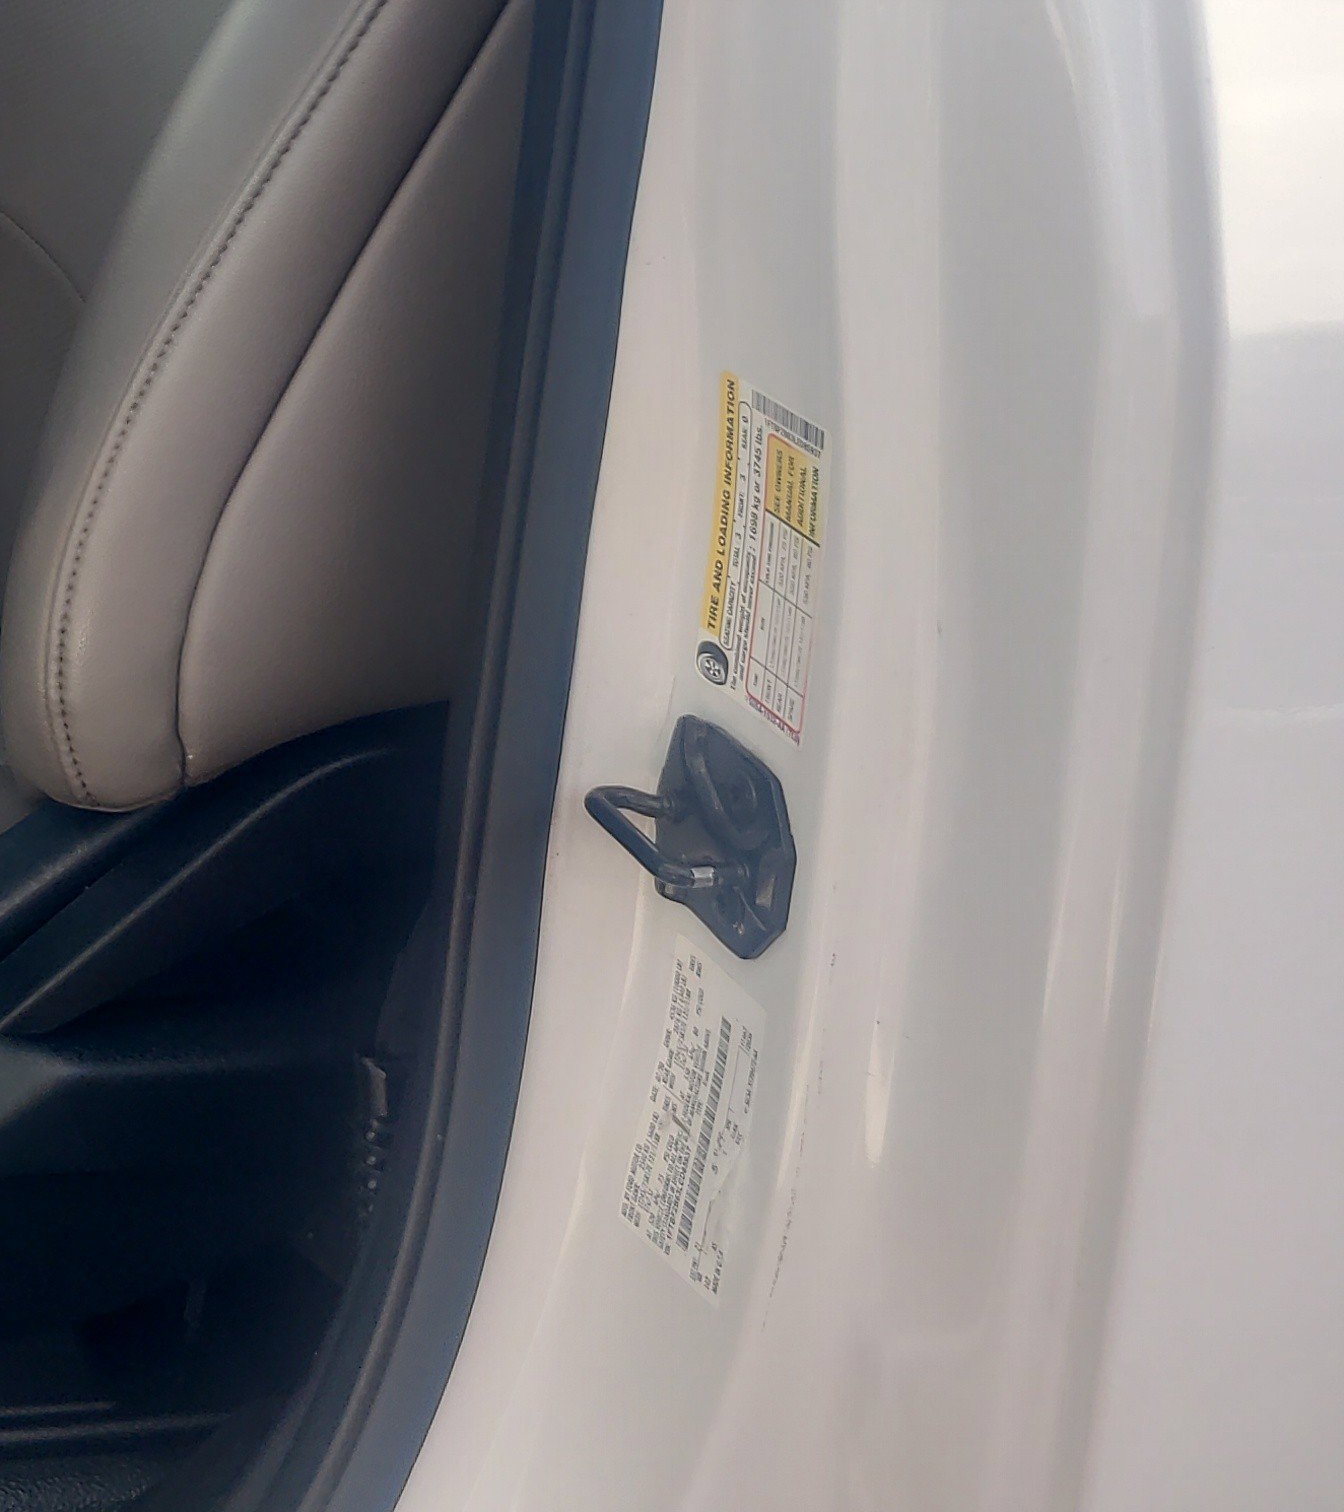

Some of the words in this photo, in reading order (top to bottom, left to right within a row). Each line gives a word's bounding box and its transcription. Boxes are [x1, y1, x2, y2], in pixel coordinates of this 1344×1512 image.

[724, 380, 734, 485] INFORMATION
[753, 448, 762, 477] 3745
[751, 496, 760, 511] kg
[717, 490, 730, 555] LOADING
[735, 532, 741, 540] 3
[713, 560, 723, 592] AND
[707, 595, 719, 628] TIRE
